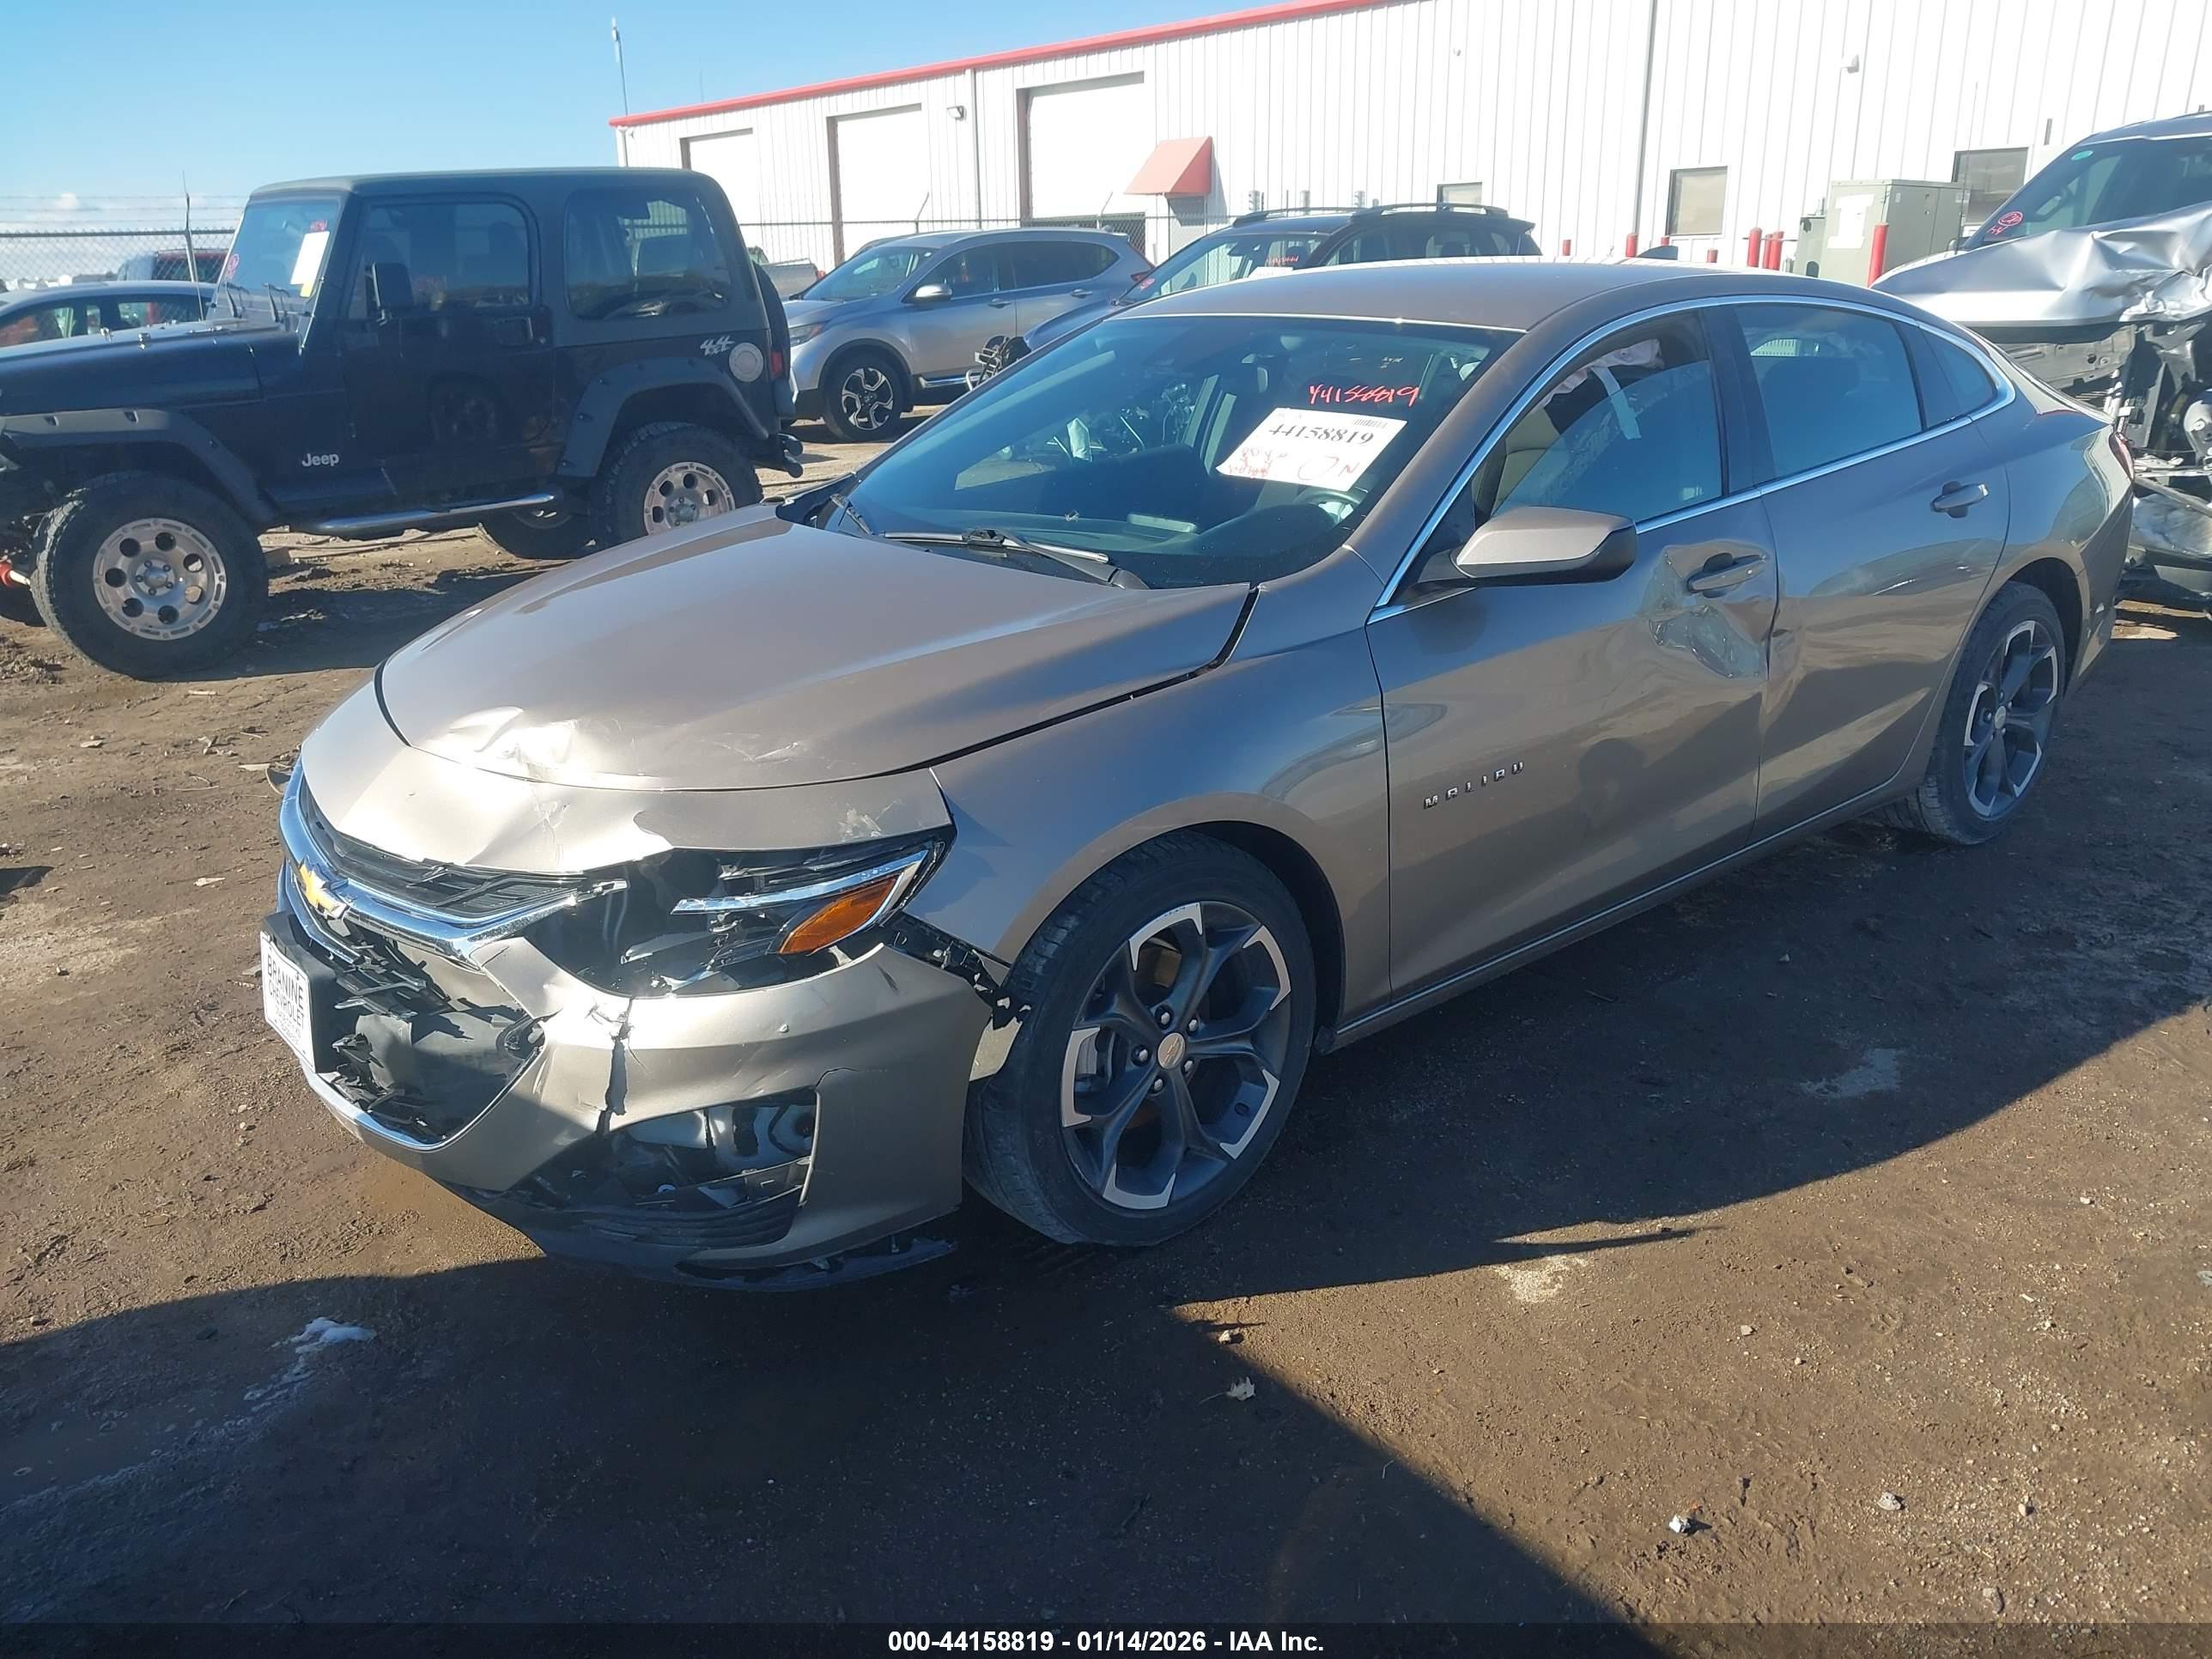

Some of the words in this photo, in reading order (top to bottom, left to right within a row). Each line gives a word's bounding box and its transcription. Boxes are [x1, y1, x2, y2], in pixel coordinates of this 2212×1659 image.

[1268, 422, 1375, 445] 44158819
[301, 453, 339, 467] Jeep
[1424, 761, 1524, 810] MALIBU
[267, 953, 304, 1011] BRANINE
[268, 979, 305, 1029] CHEVROLET
